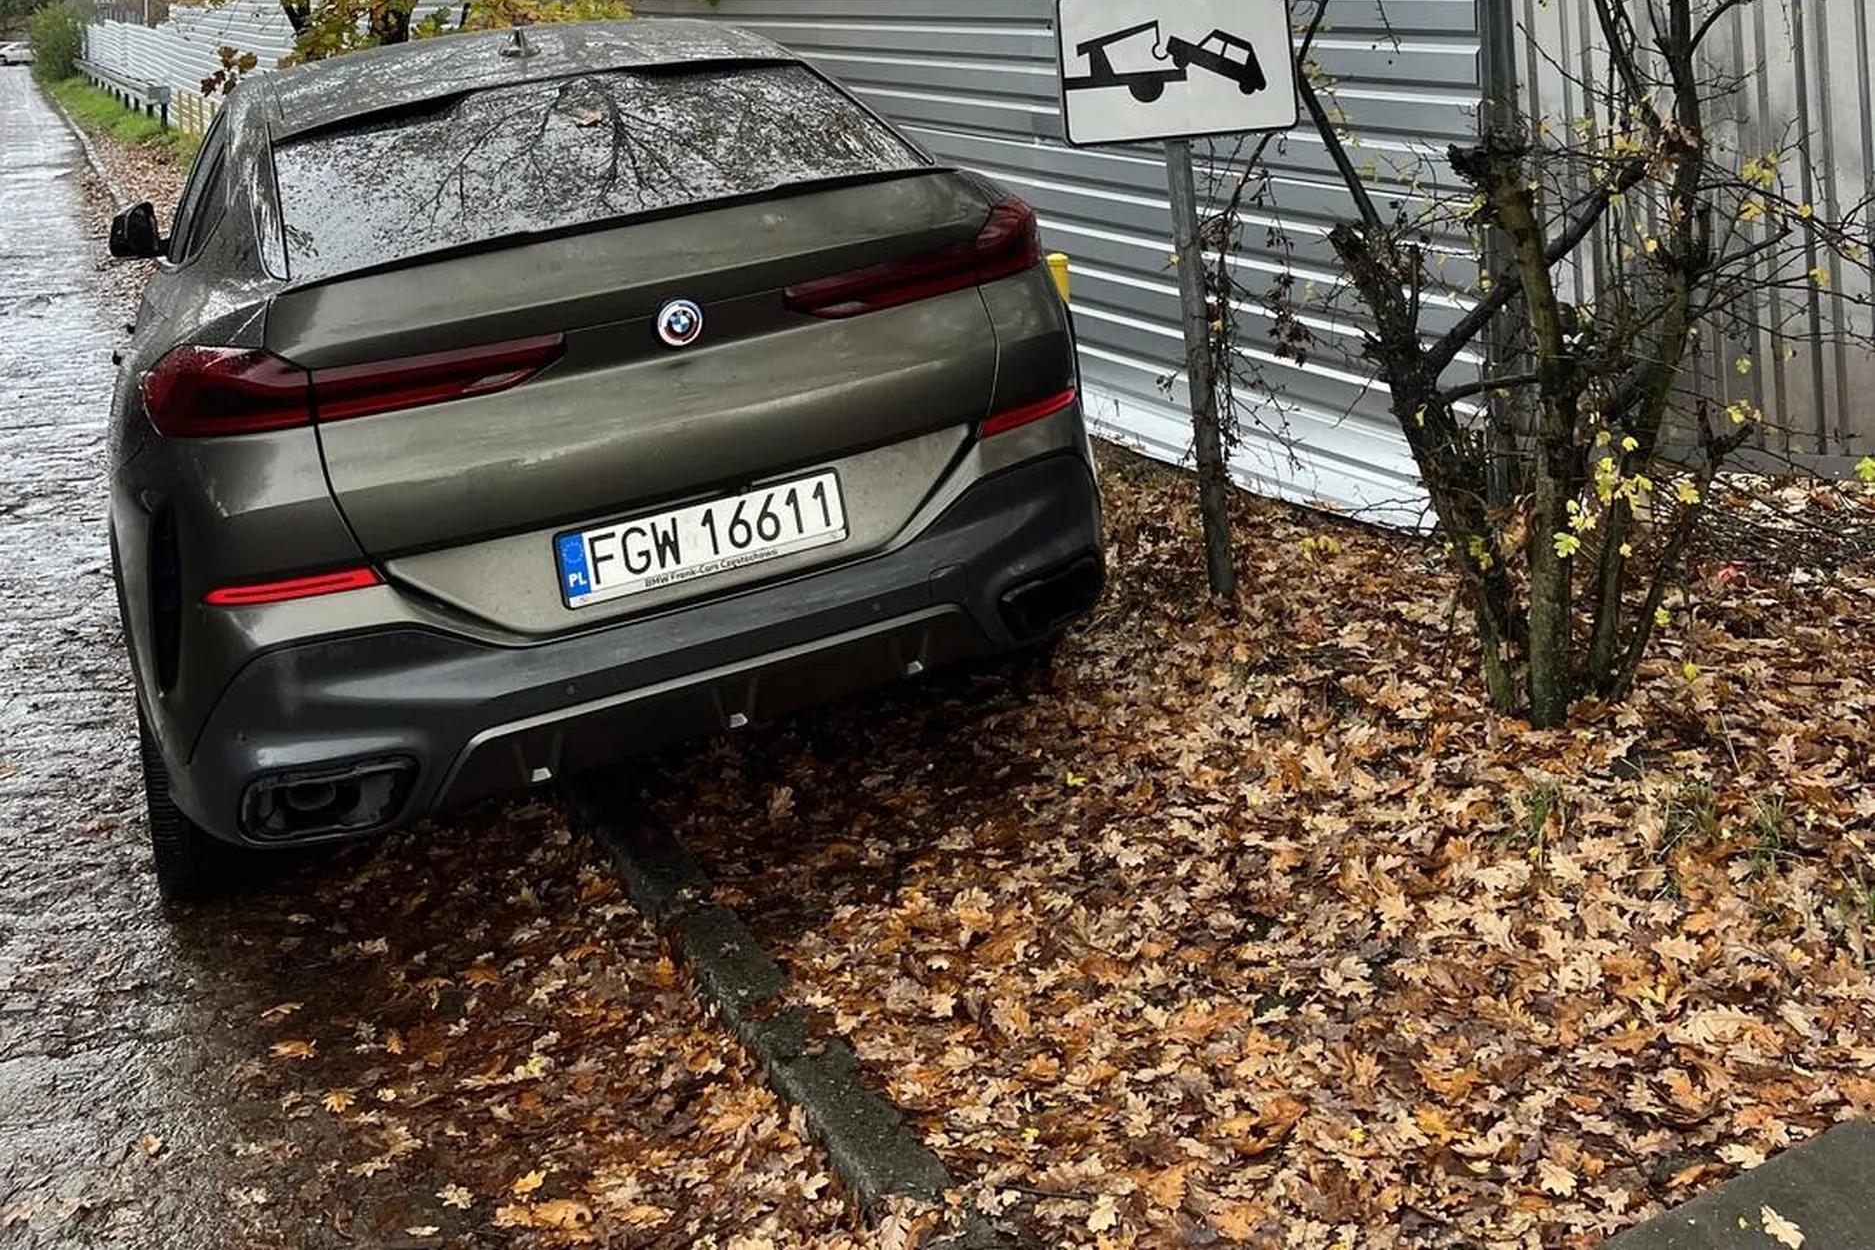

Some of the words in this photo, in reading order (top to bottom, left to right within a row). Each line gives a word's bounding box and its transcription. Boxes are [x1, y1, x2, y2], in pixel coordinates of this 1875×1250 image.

[588, 516, 682, 585] FGW
[701, 481, 832, 555] 16611
[568, 572, 588, 587] PL
[644, 574, 669, 587] BMW
